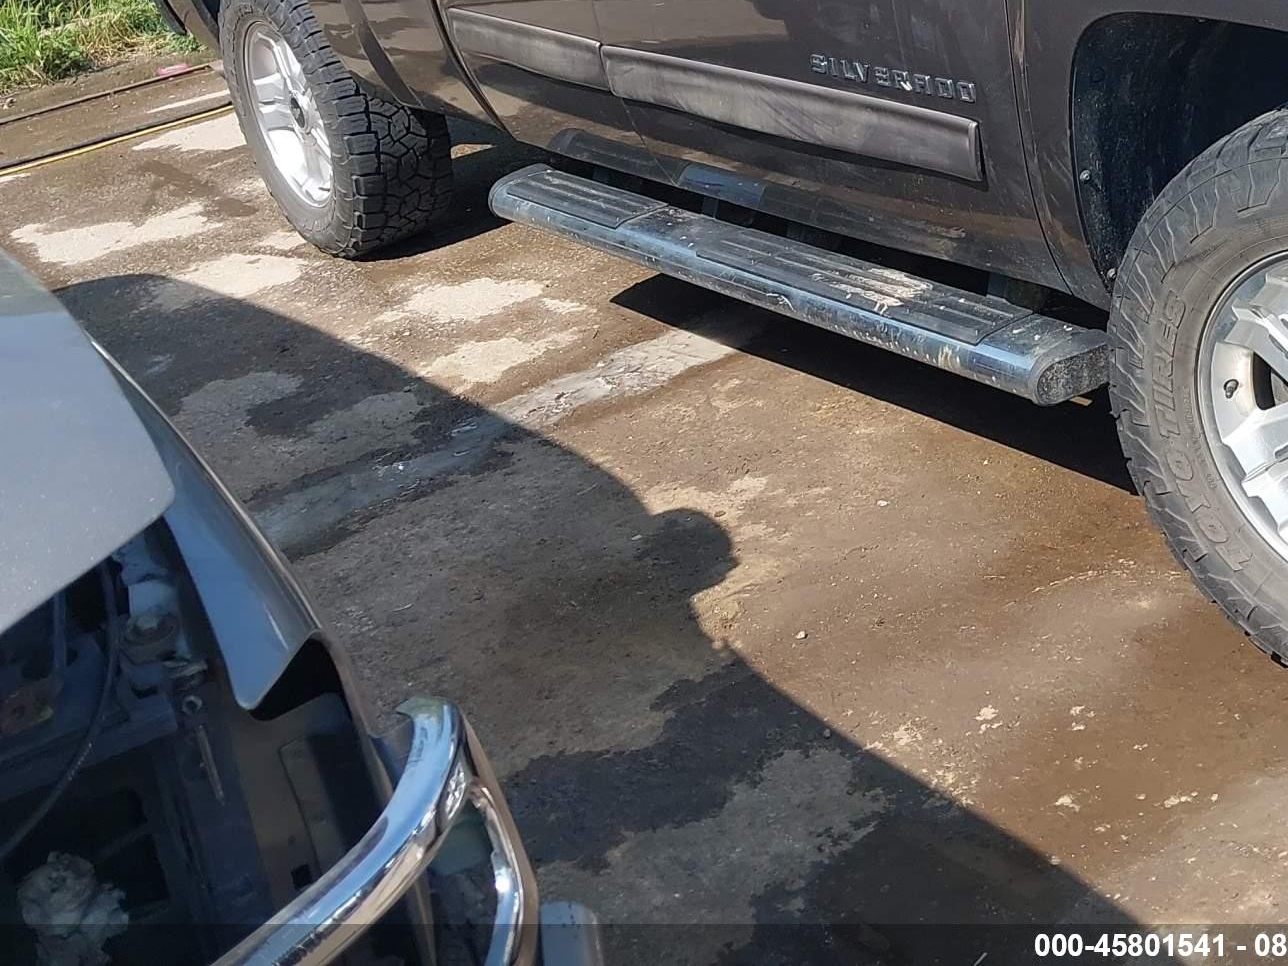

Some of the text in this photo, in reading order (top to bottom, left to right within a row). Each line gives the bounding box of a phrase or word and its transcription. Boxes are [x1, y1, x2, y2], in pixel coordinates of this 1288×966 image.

[810, 54, 977, 103] SILVERADO
[1151, 289, 1186, 438] TIRES
[1164, 448, 1253, 572] TOYO
